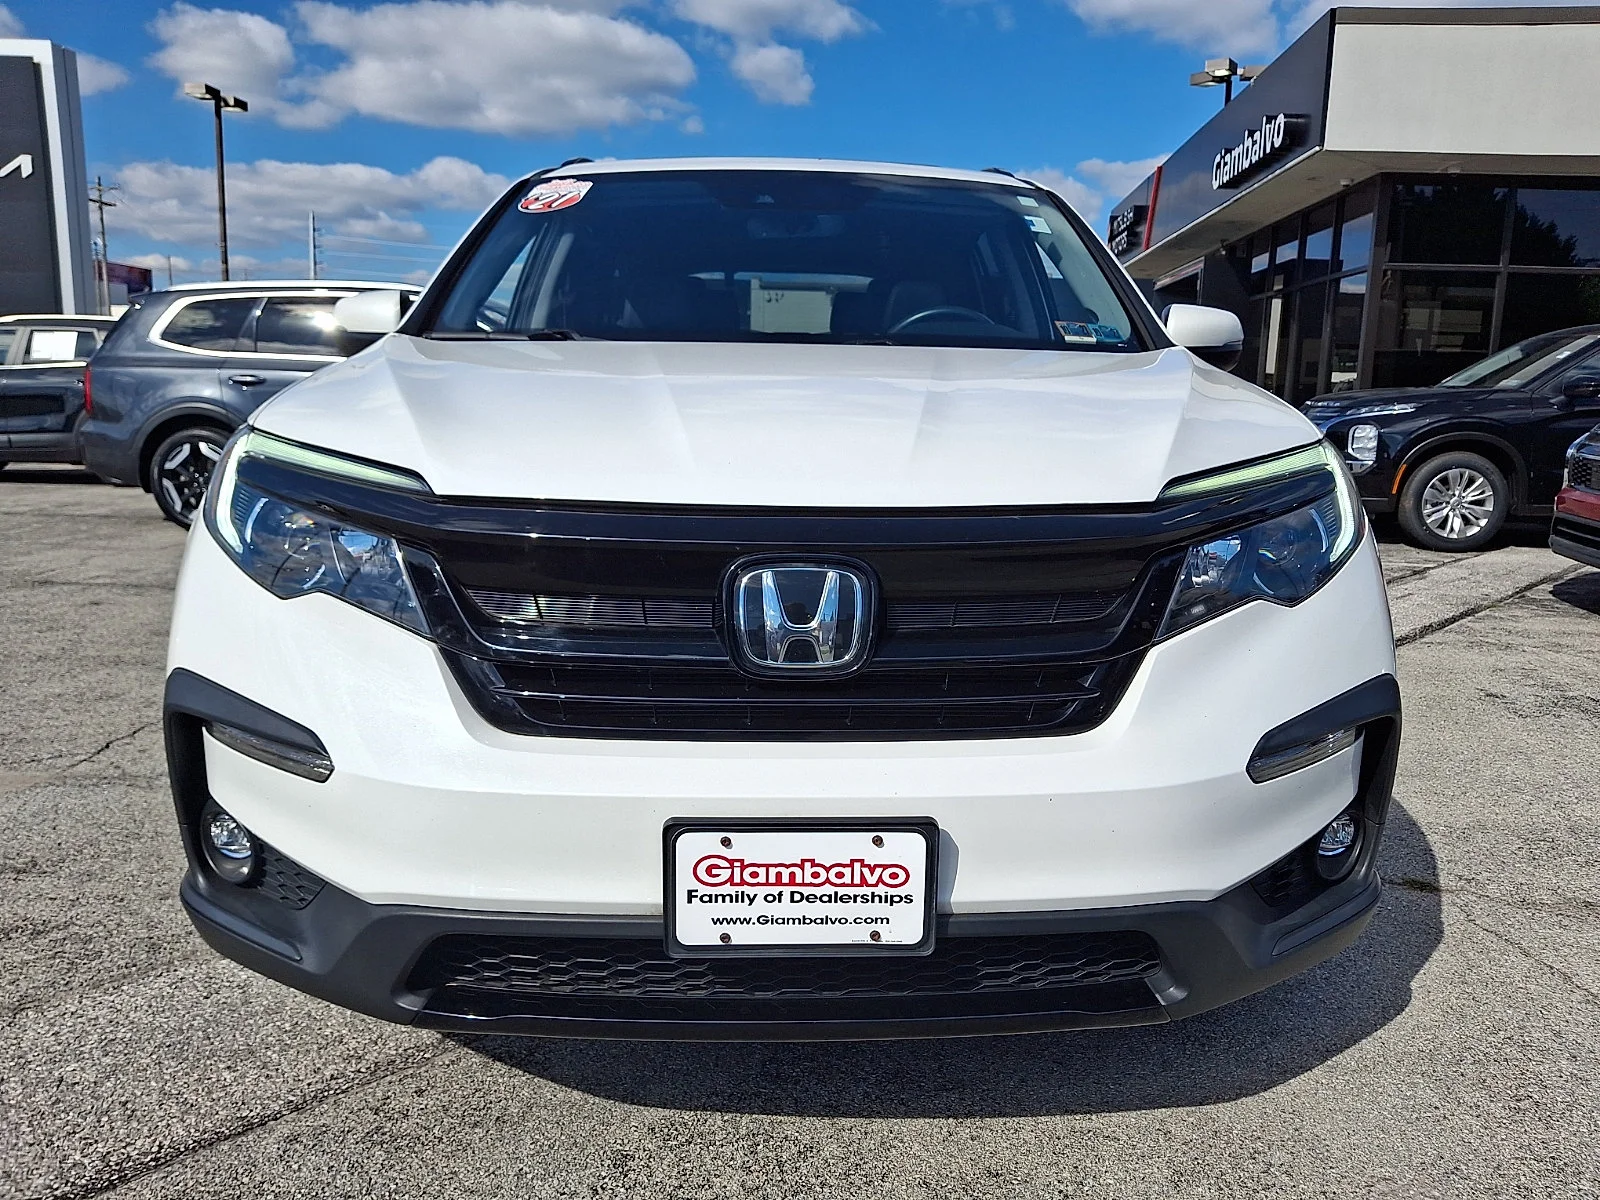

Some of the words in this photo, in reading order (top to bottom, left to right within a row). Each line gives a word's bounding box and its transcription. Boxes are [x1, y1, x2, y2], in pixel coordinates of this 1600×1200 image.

[1212, 113, 1284, 190] Giambalvo
[693, 855, 910, 888] Giambalvo
[686, 889, 758, 906] Family
[763, 891, 784, 904] of
[790, 891, 914, 906] Dealerships
[711, 914, 890, 926] www.Giambalvo.com
